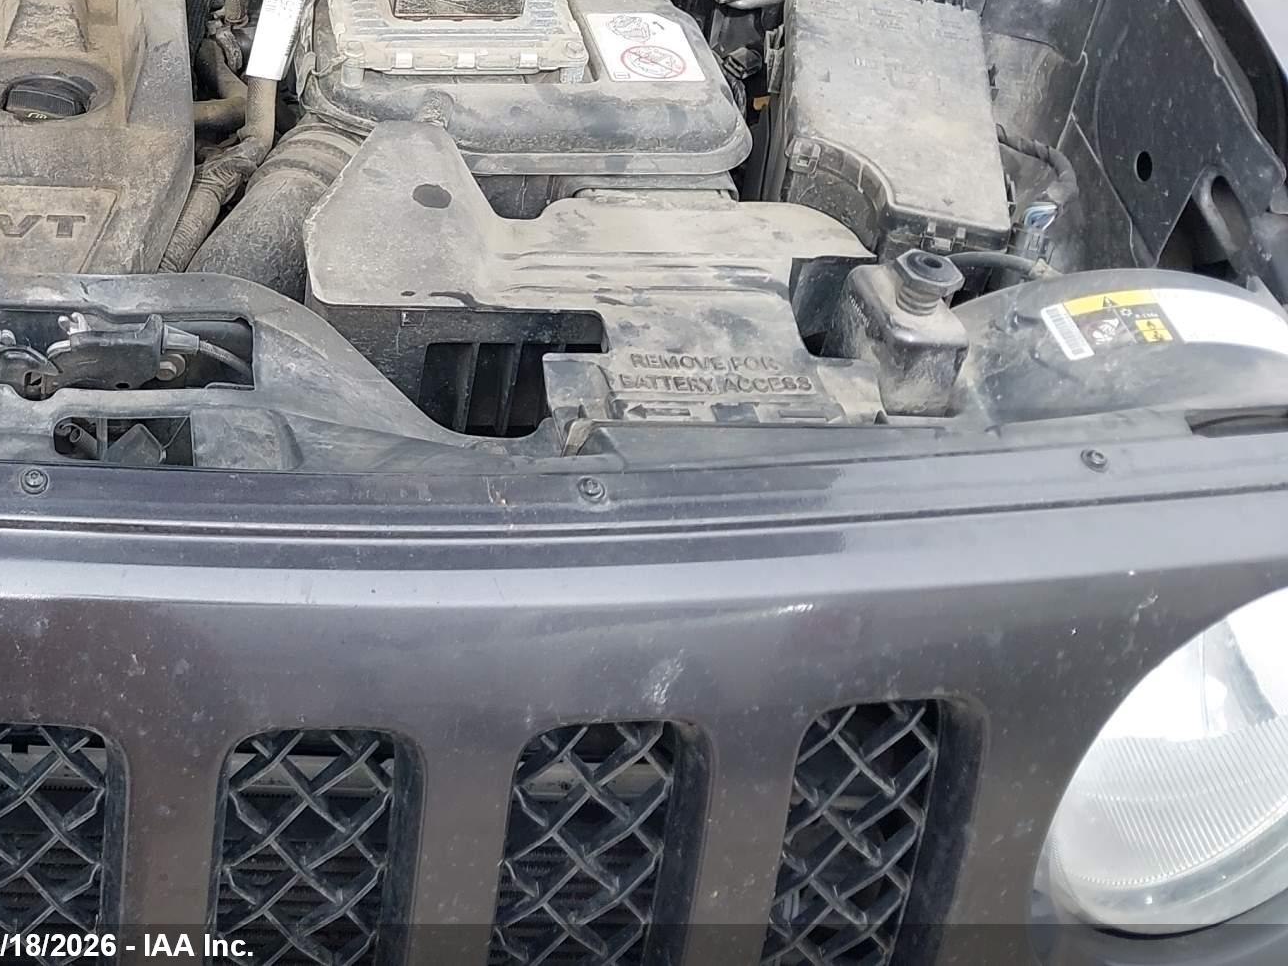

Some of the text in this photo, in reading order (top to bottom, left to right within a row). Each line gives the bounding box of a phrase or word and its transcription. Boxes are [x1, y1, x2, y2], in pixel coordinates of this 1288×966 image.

[630, 353, 781, 372] REMOVE FOR
[618, 374, 813, 393] BATTERY ACCESS
